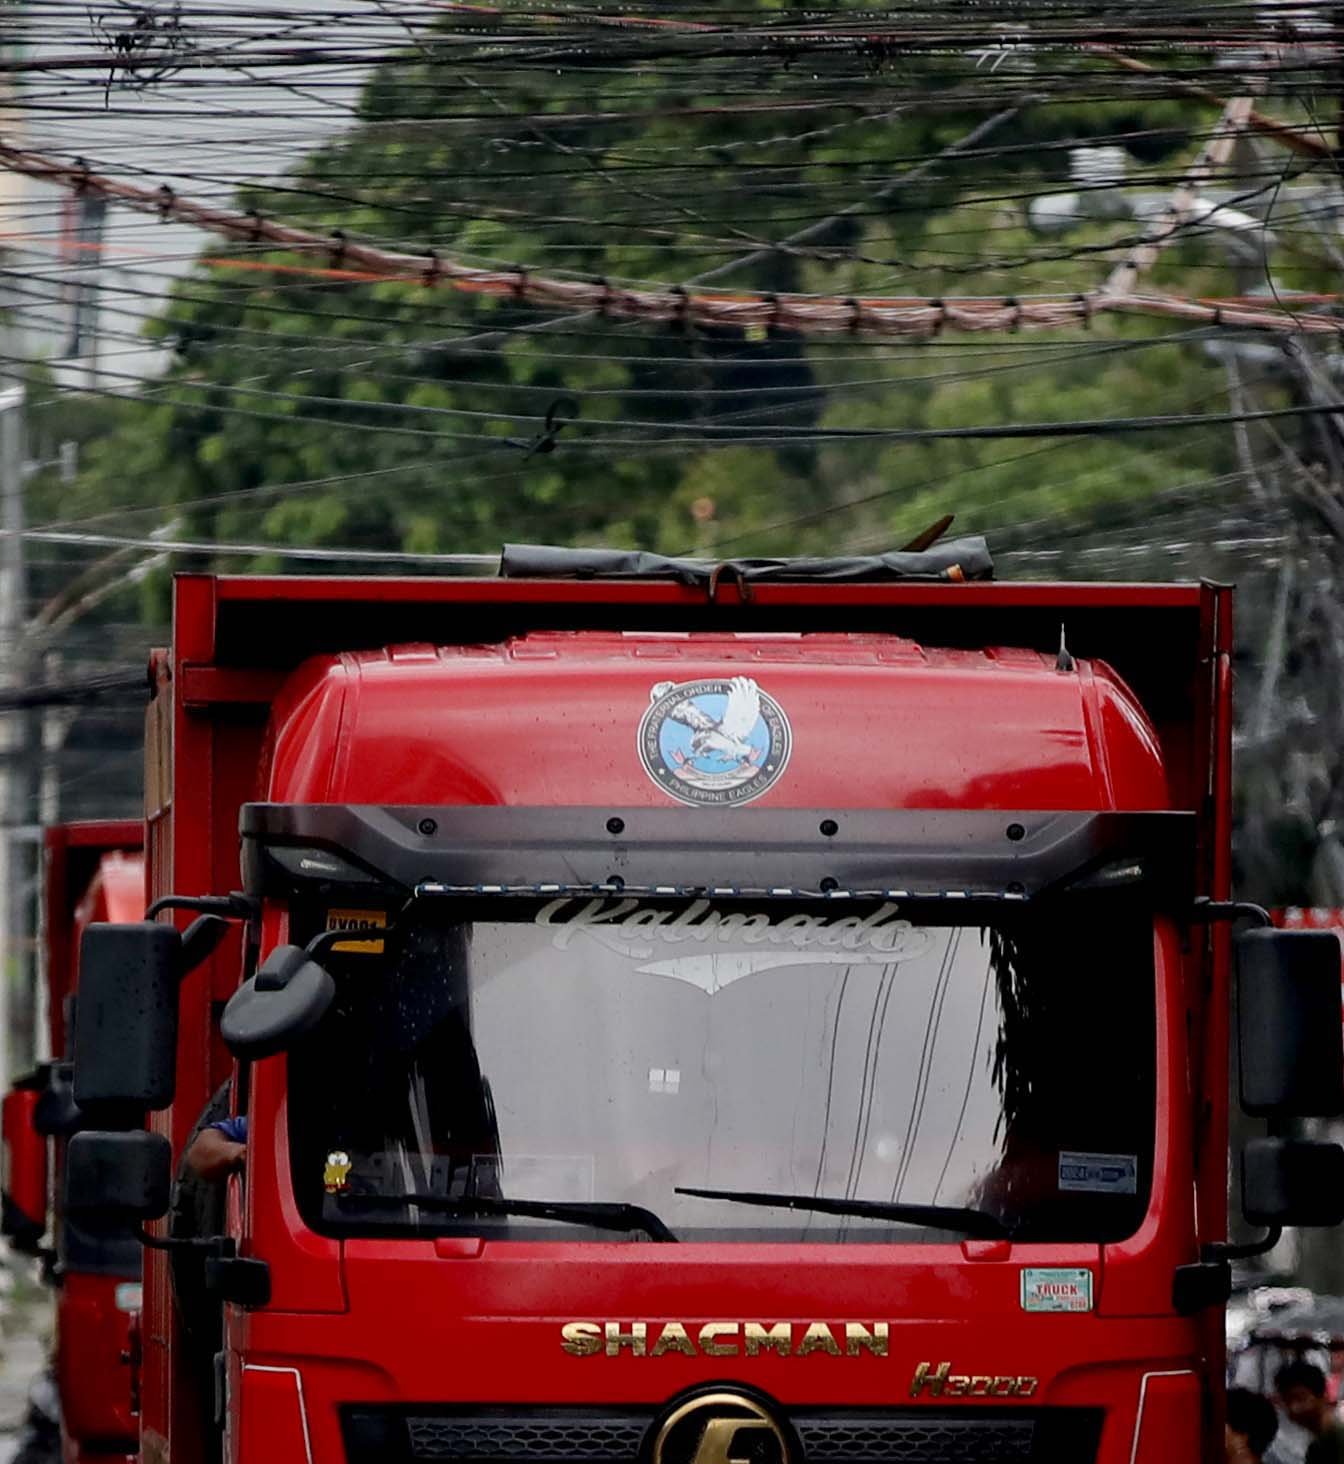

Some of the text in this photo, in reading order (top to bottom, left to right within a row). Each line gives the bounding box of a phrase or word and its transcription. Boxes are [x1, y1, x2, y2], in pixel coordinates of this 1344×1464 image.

[1035, 1283, 1079, 1296] TRUCK
[560, 1321, 890, 1357] SHACMAN
[910, 1360, 1040, 1399] H3000
